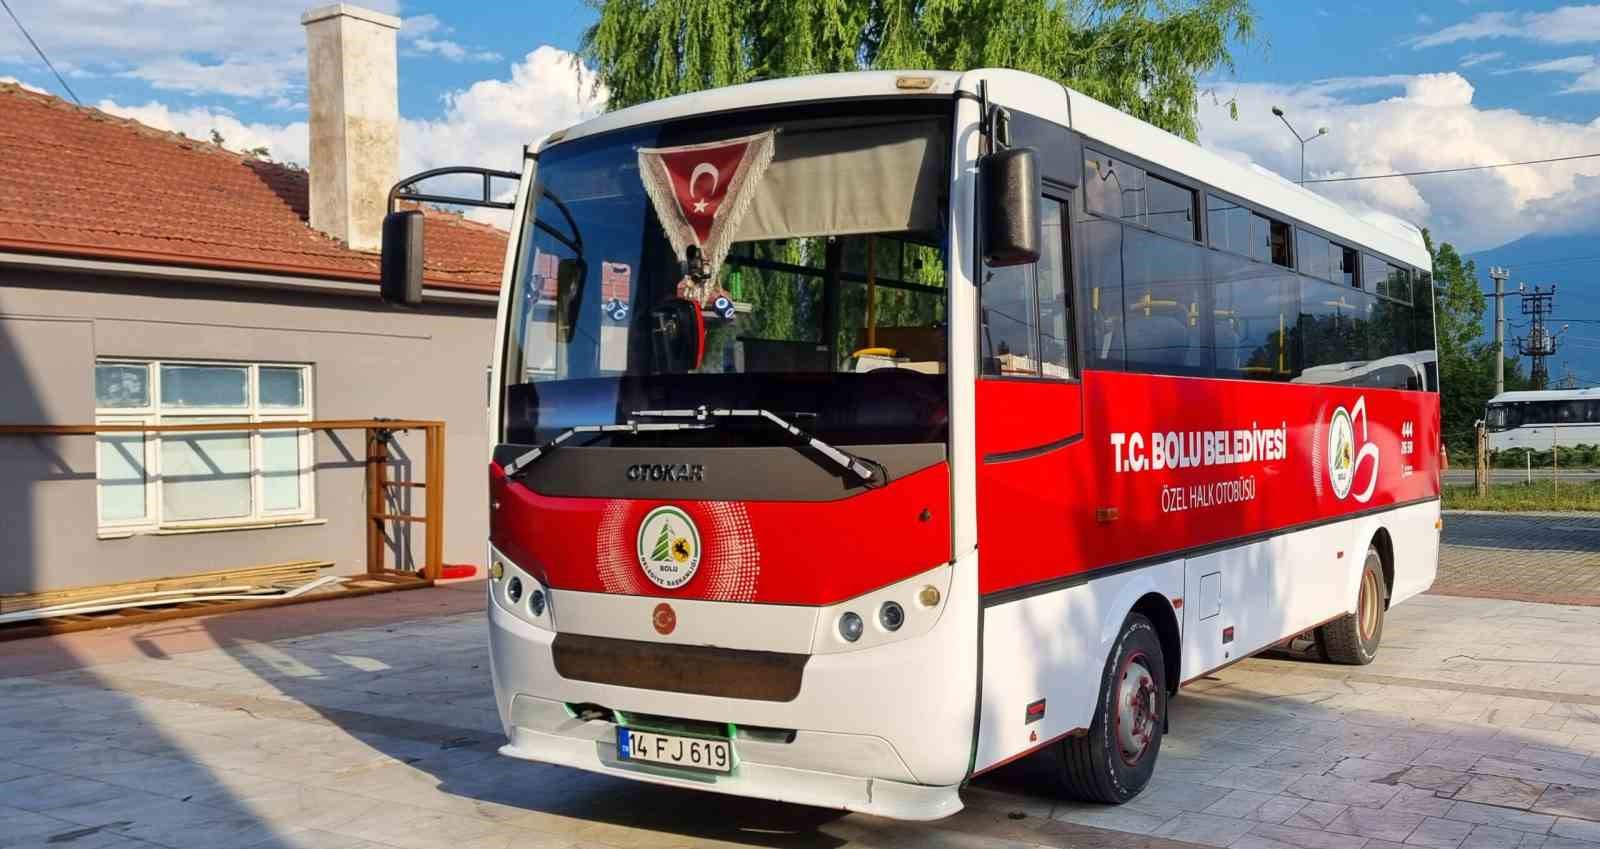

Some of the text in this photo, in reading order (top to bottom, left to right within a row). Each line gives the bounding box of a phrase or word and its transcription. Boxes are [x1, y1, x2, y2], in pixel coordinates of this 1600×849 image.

[1110, 421, 1286, 472] T.C. BOLU BELEDİYESİ
[626, 463, 704, 481] OTOKAR
[1161, 475, 1256, 513] ÖZEL HALK OTOBÜSÜ
[630, 733, 647, 757] 14
[691, 742, 726, 766] 619
